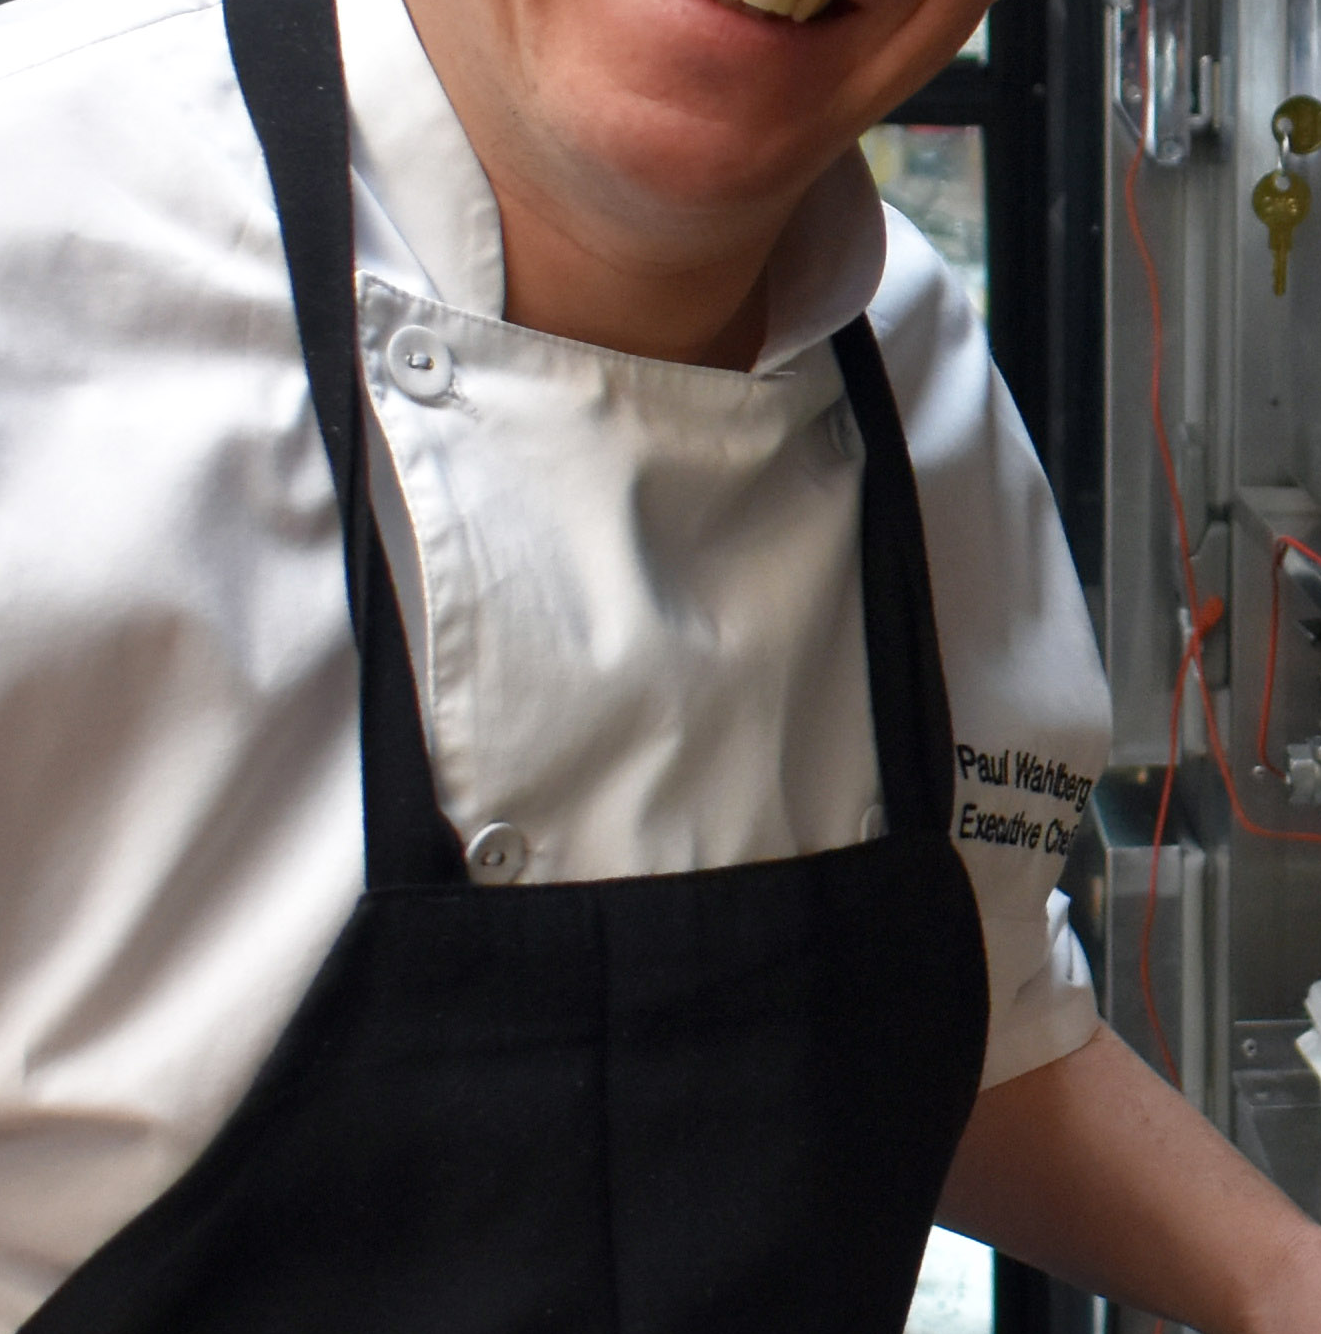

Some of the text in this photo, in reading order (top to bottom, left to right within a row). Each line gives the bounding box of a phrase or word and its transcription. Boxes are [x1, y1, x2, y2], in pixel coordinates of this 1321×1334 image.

[956, 744, 1093, 812] Paul Wahlberg
[958, 803, 1042, 850] Executive
